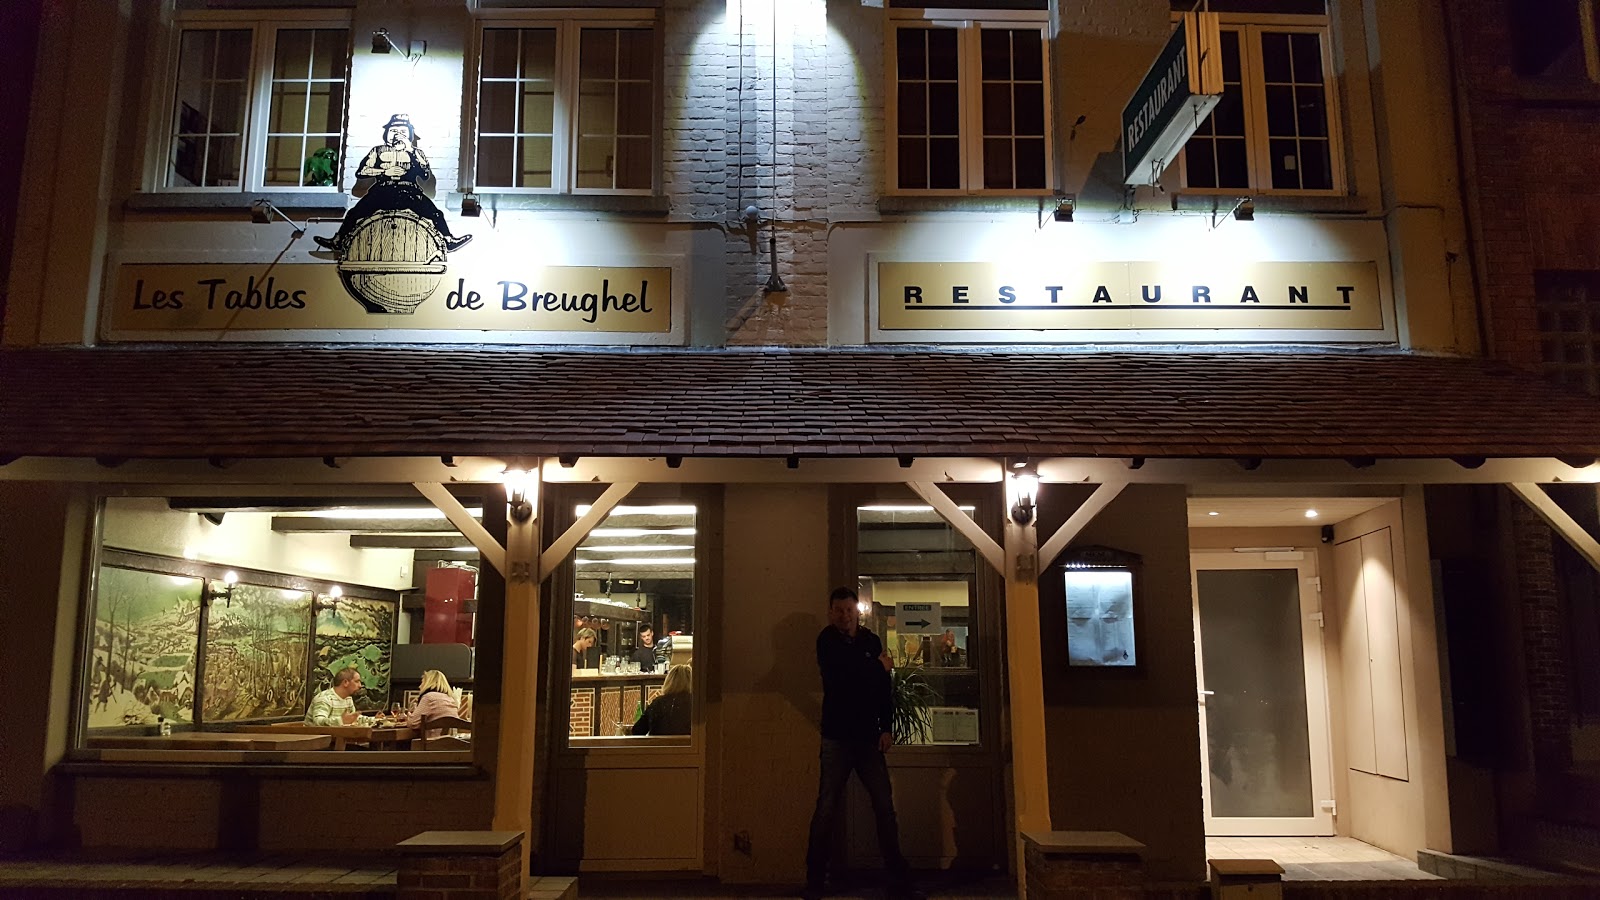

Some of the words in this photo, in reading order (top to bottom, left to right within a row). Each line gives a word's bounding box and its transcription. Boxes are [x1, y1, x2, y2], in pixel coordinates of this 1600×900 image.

[1127, 46, 1186, 152] RESTAURANT
[133, 279, 183, 310] Les
[199, 278, 307, 310] Tables
[446, 278, 484, 311] de
[497, 279, 652, 322] Breughel
[904, 286, 1355, 303] RESTAURANT
